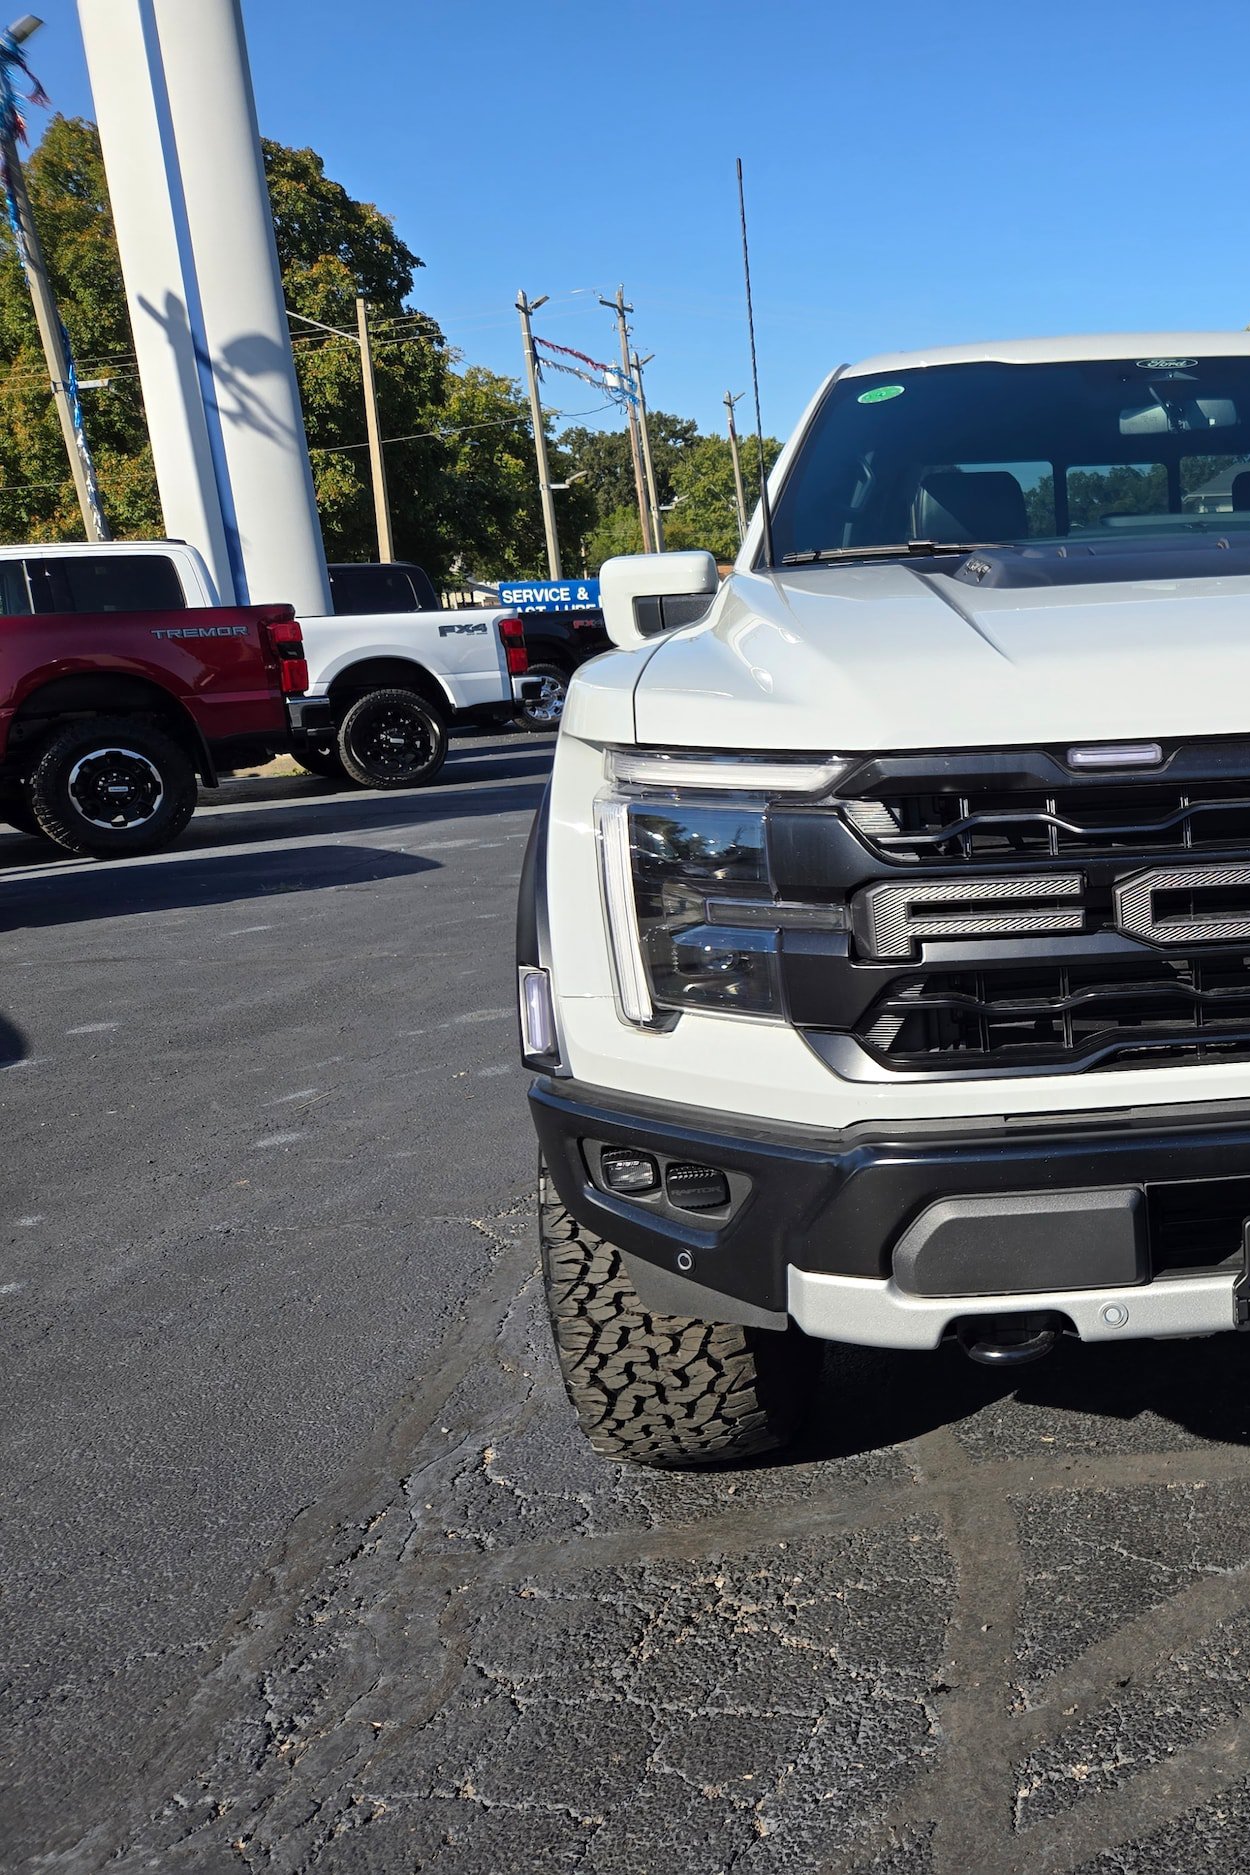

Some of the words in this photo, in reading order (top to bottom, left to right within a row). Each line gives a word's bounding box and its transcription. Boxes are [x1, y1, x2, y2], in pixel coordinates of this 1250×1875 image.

[502, 588, 571, 603] SERVICE
[577, 587, 589, 600] &
[151, 626, 248, 639] TREMOR
[438, 623, 487, 637] FX4
[671, 1186, 721, 1196] RAPTOR
